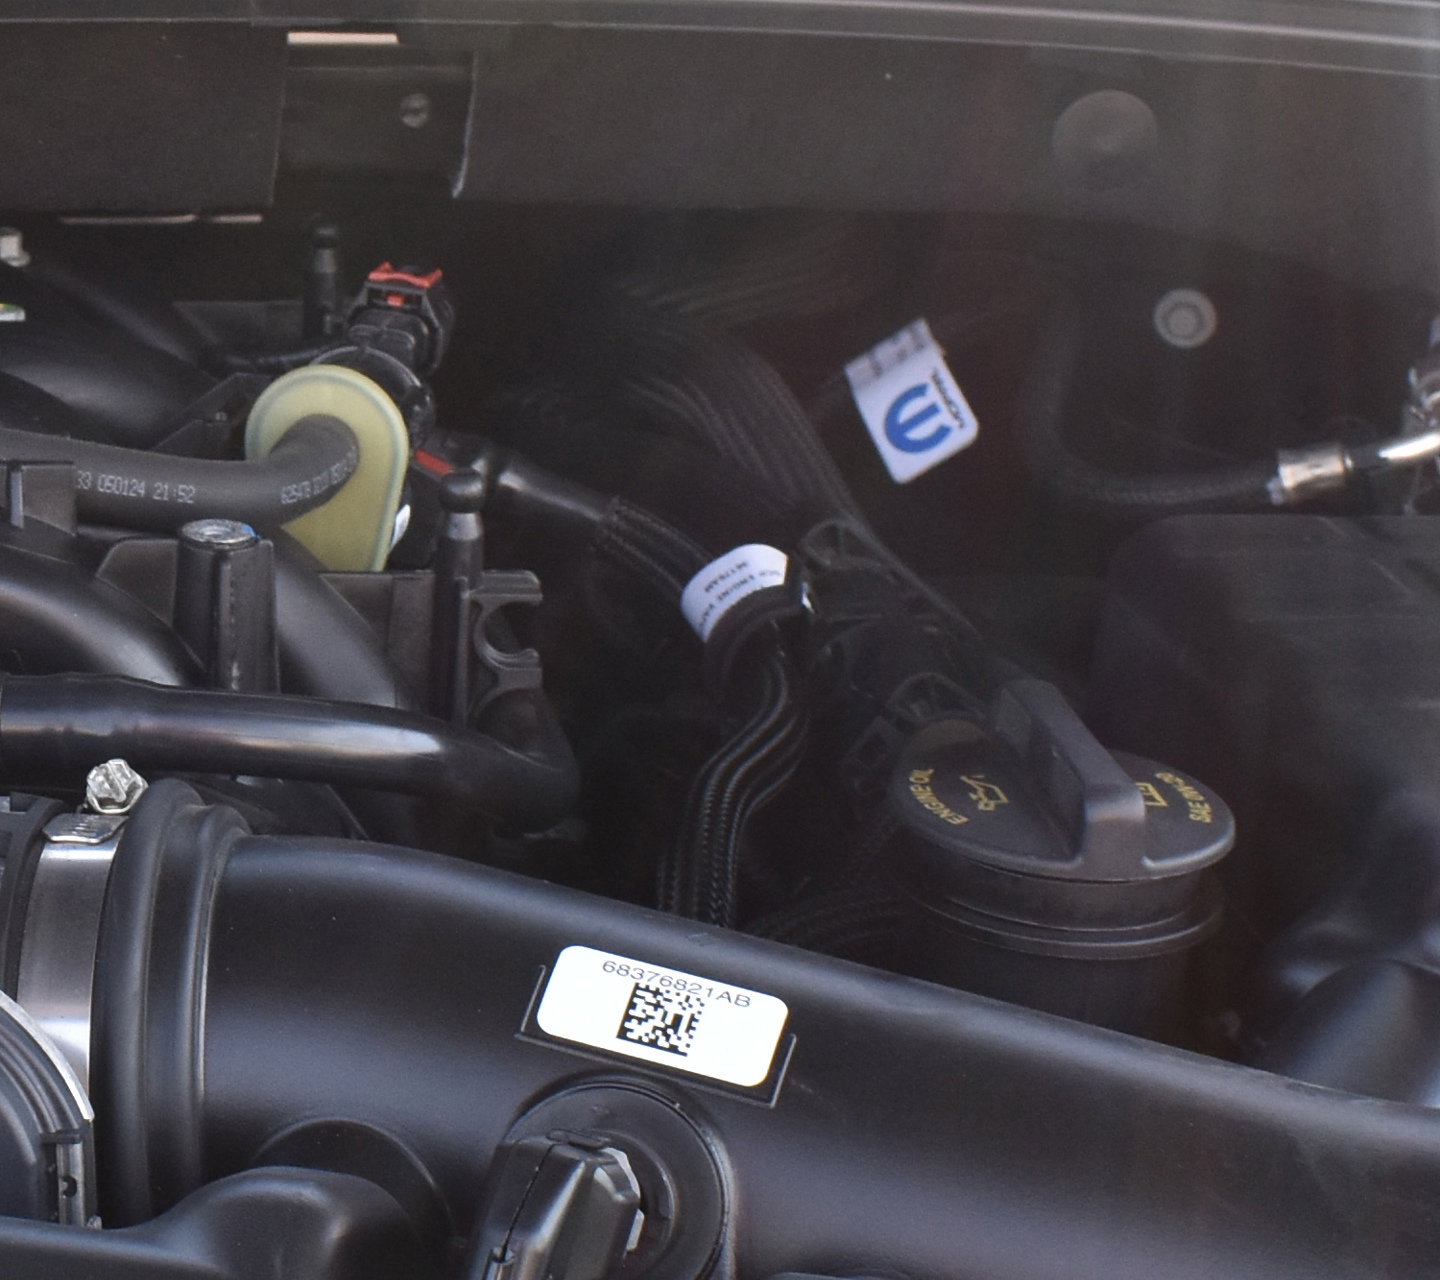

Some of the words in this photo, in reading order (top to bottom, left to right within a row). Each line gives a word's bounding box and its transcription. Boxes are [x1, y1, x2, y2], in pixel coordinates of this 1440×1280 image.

[909, 784, 969, 825] ENGINE
[1187, 801, 1212, 823] SAE
[602, 960, 752, 1008] 68376821AB
